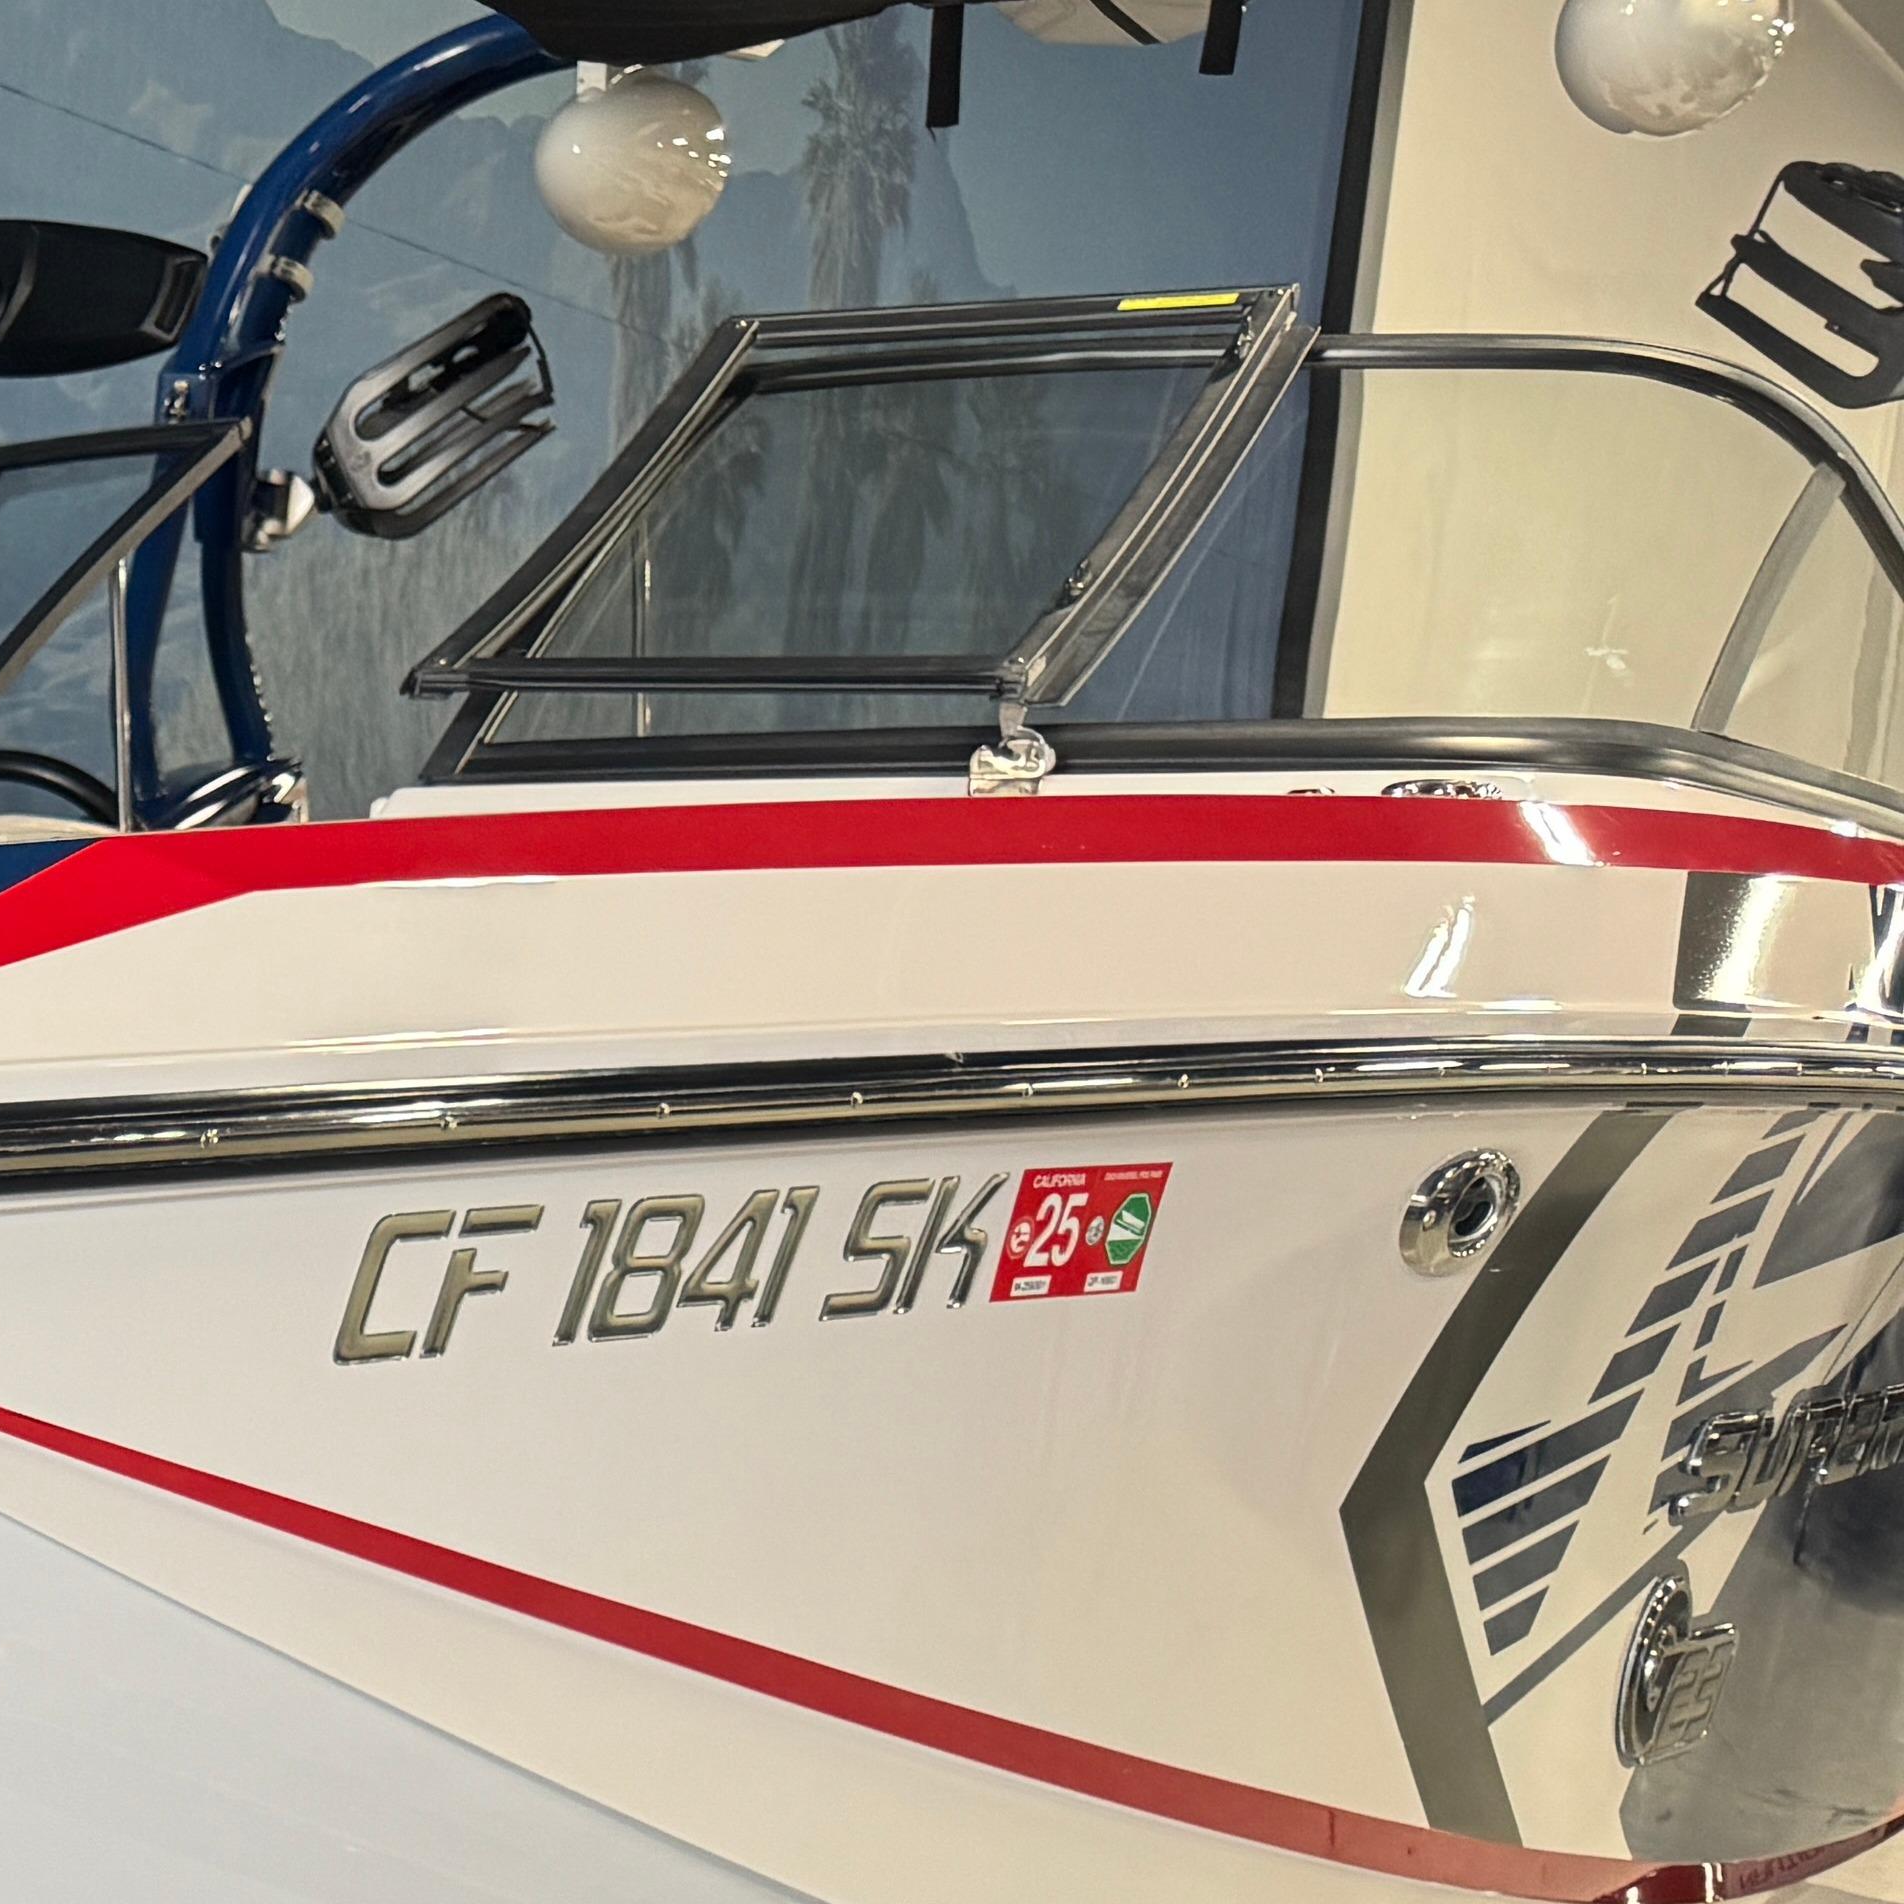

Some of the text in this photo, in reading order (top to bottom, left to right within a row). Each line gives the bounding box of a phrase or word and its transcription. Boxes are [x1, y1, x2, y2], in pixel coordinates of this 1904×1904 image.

[333, 1171, 1010, 1366] CF 1841 SK
[1023, 1193, 1089, 1268] 25
